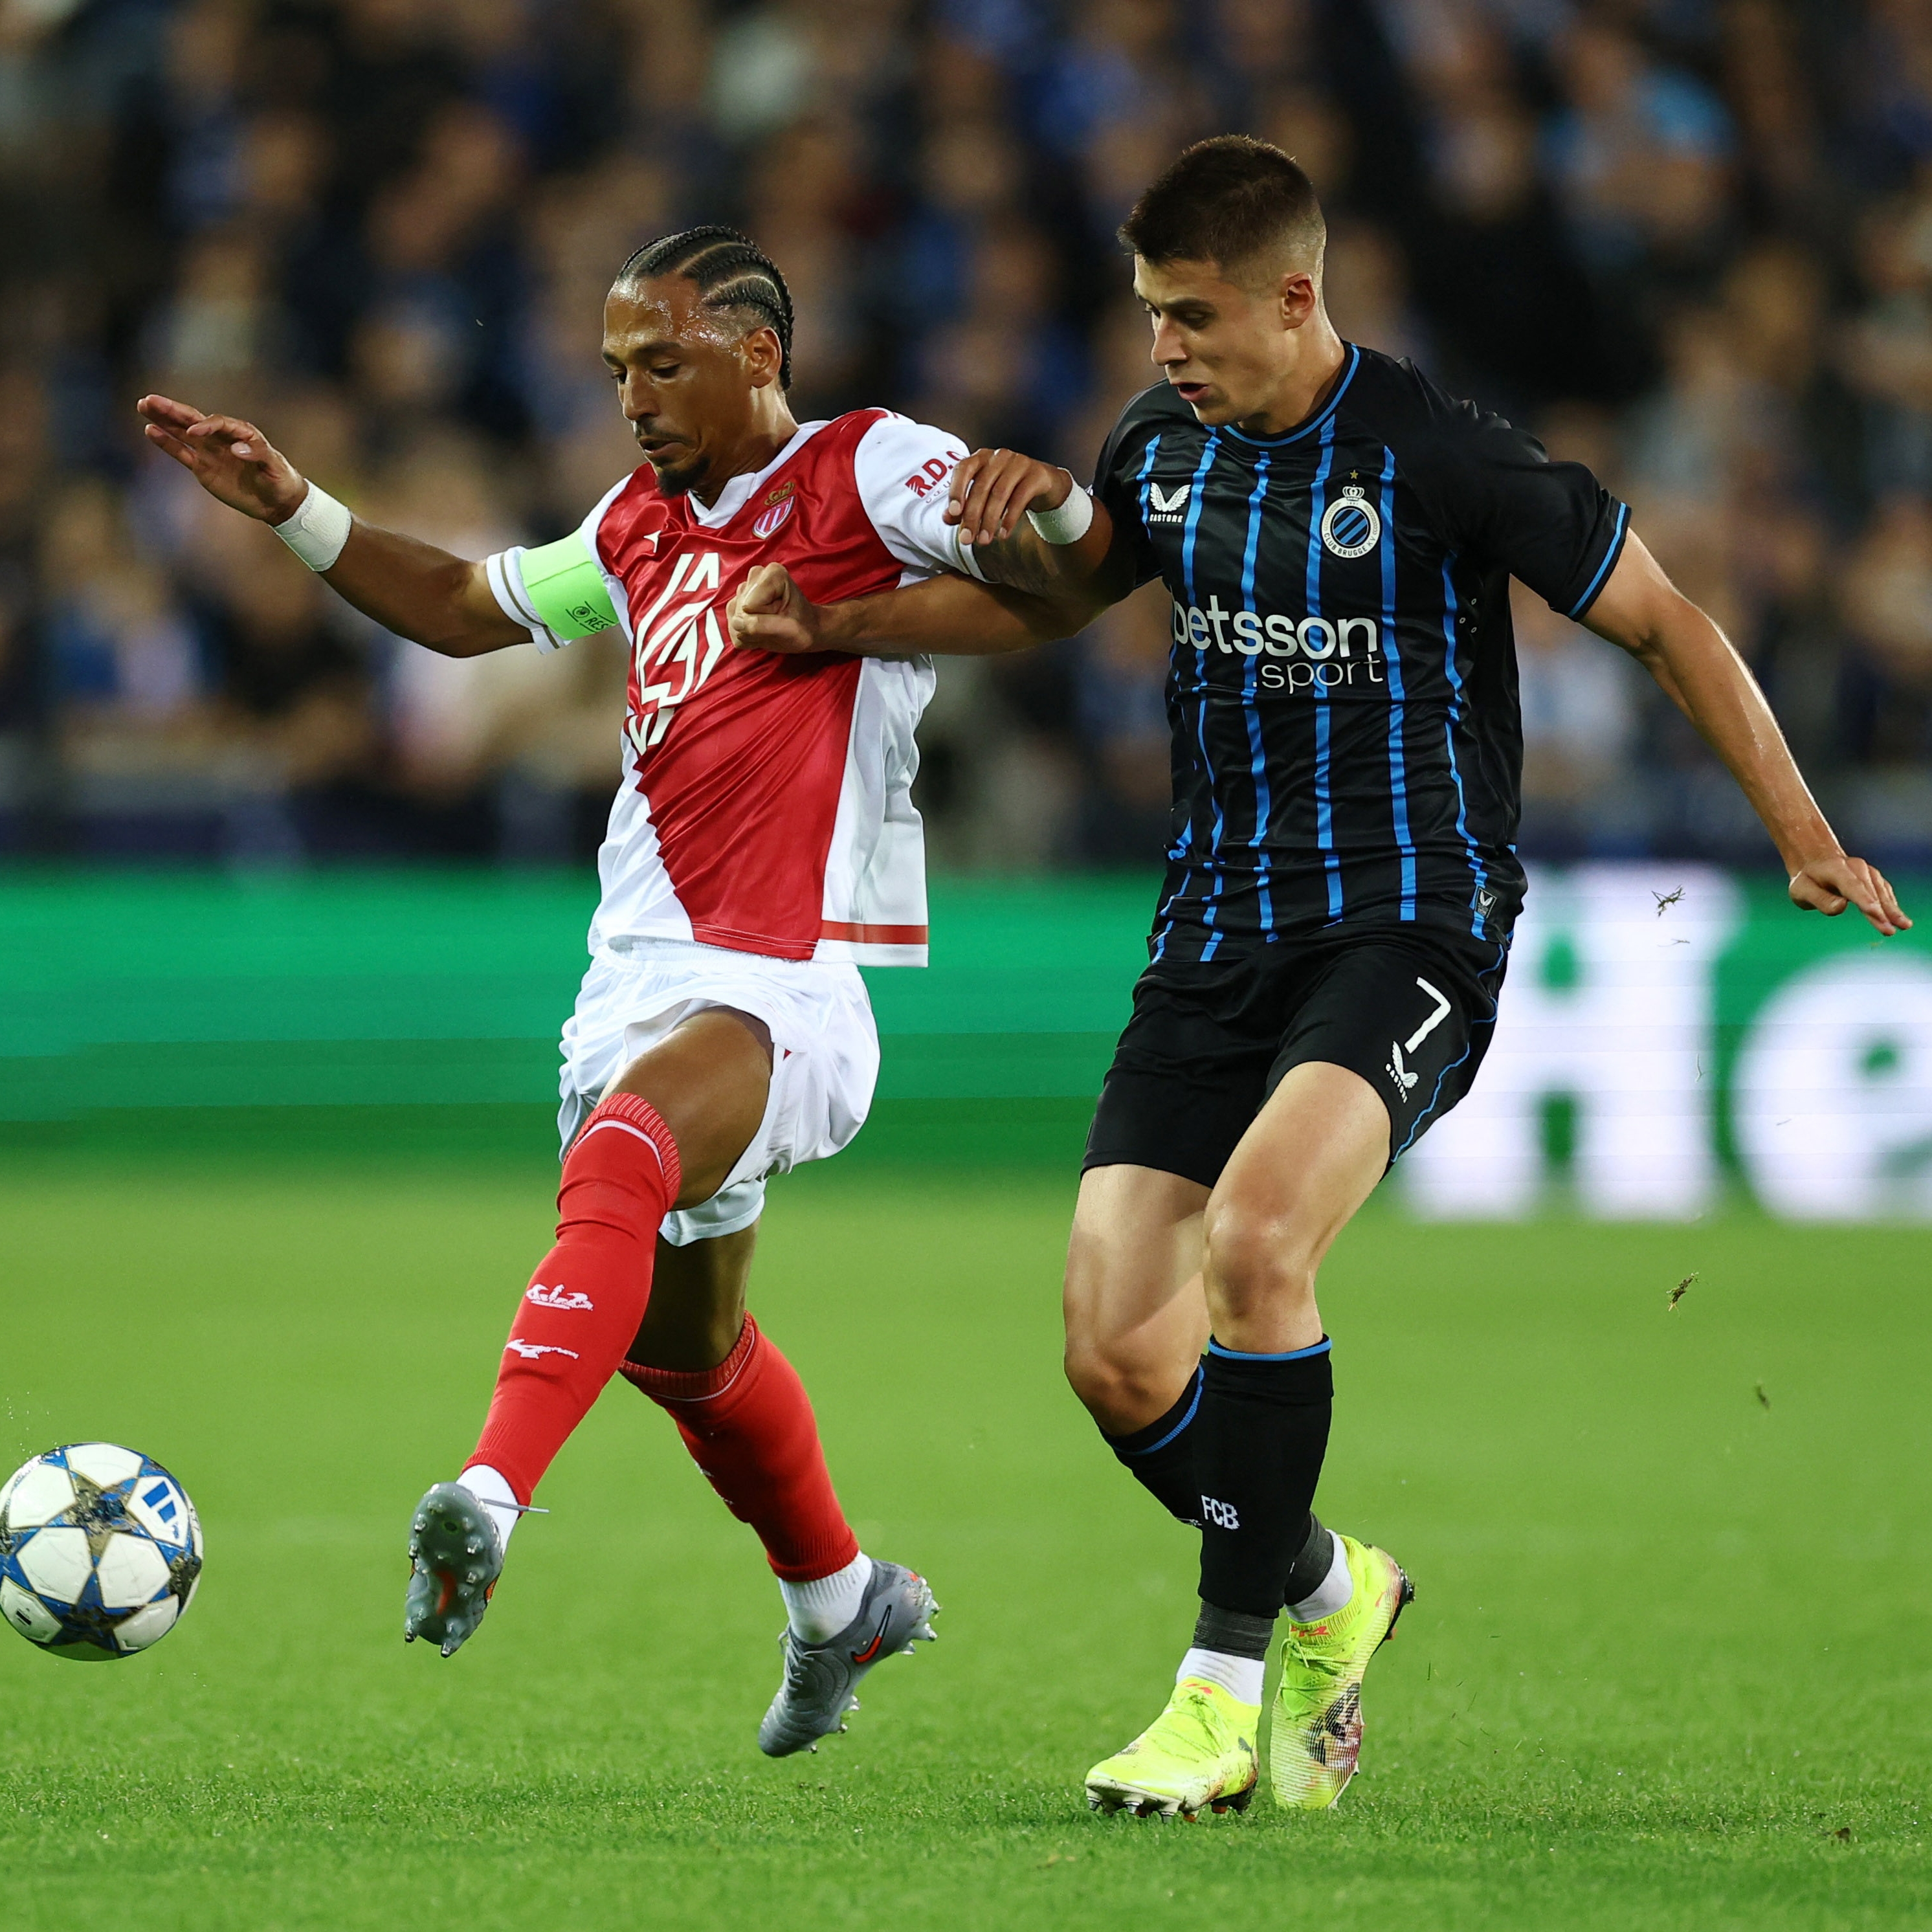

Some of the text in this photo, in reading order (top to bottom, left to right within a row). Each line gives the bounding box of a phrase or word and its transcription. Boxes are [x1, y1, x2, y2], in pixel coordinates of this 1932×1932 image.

[1149, 513, 1184, 523] CASTORE
[1324, 532, 1337, 551] CLUB
[1337, 545, 1368, 557] BRUGGE
[584, 617, 610, 630] RES
[1404, 977, 1452, 1054] 7
[1201, 1494, 1241, 1530] FCB
